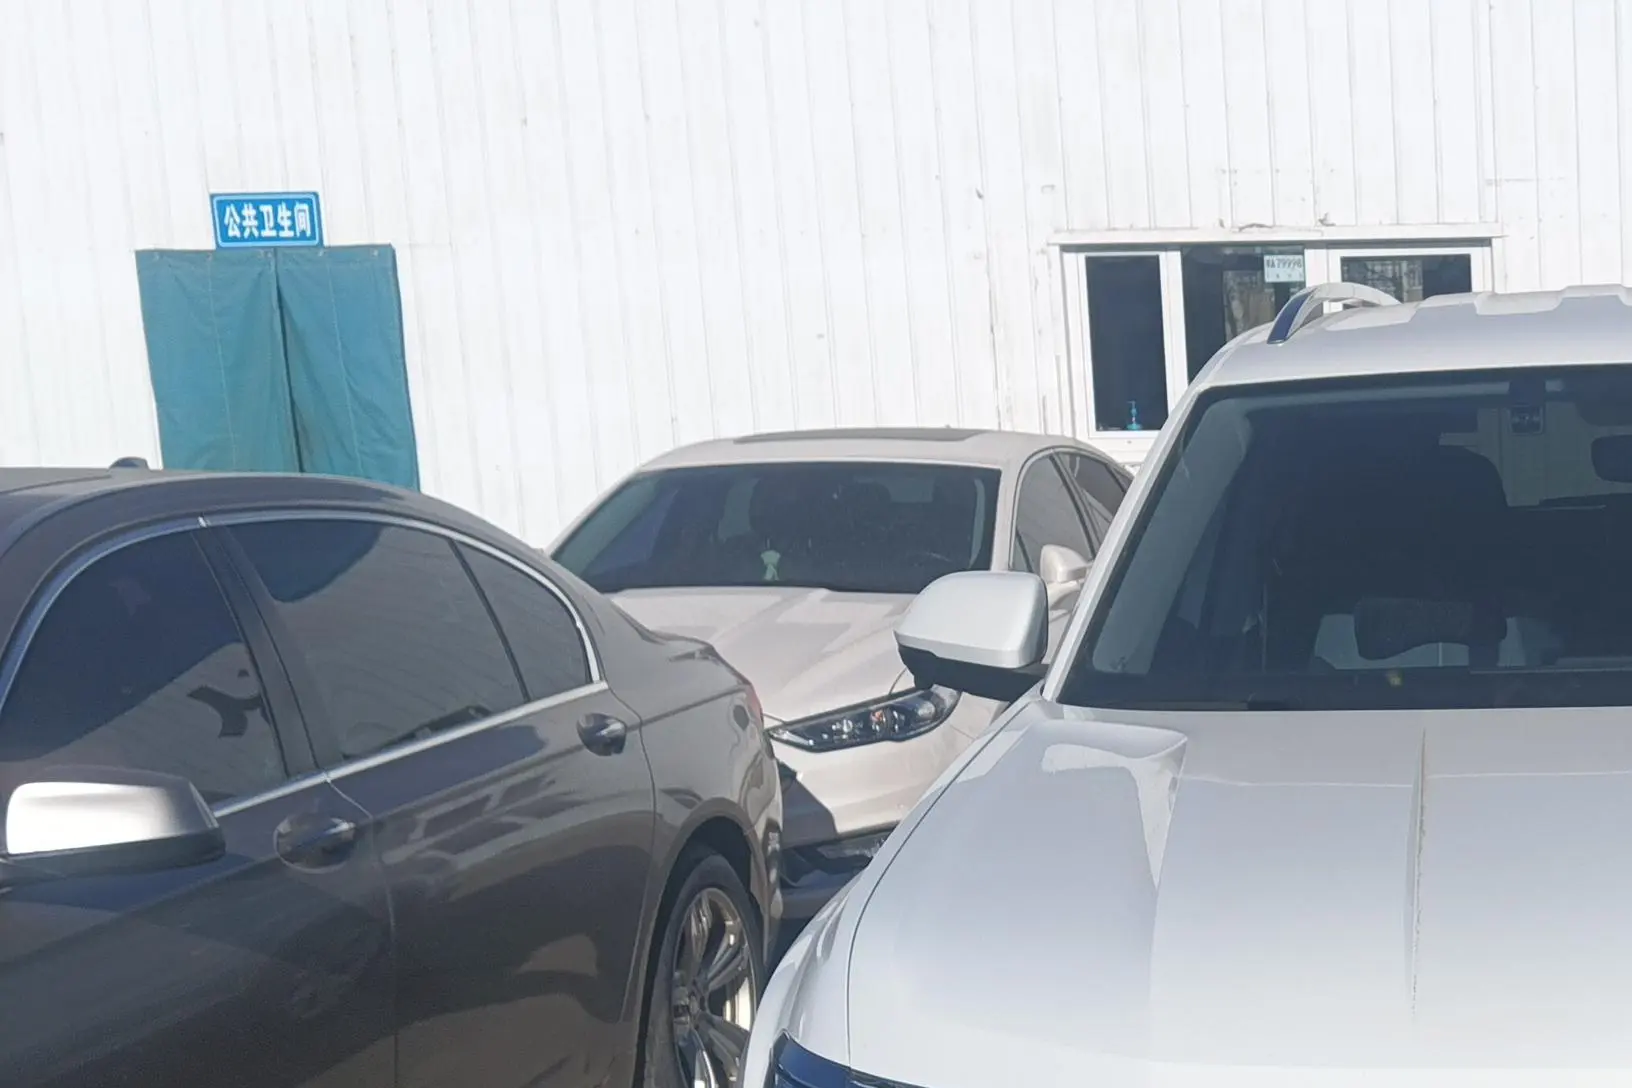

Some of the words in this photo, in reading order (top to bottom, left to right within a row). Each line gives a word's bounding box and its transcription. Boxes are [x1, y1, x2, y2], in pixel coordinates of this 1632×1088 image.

[224, 201, 311, 238] 公共卫生间
